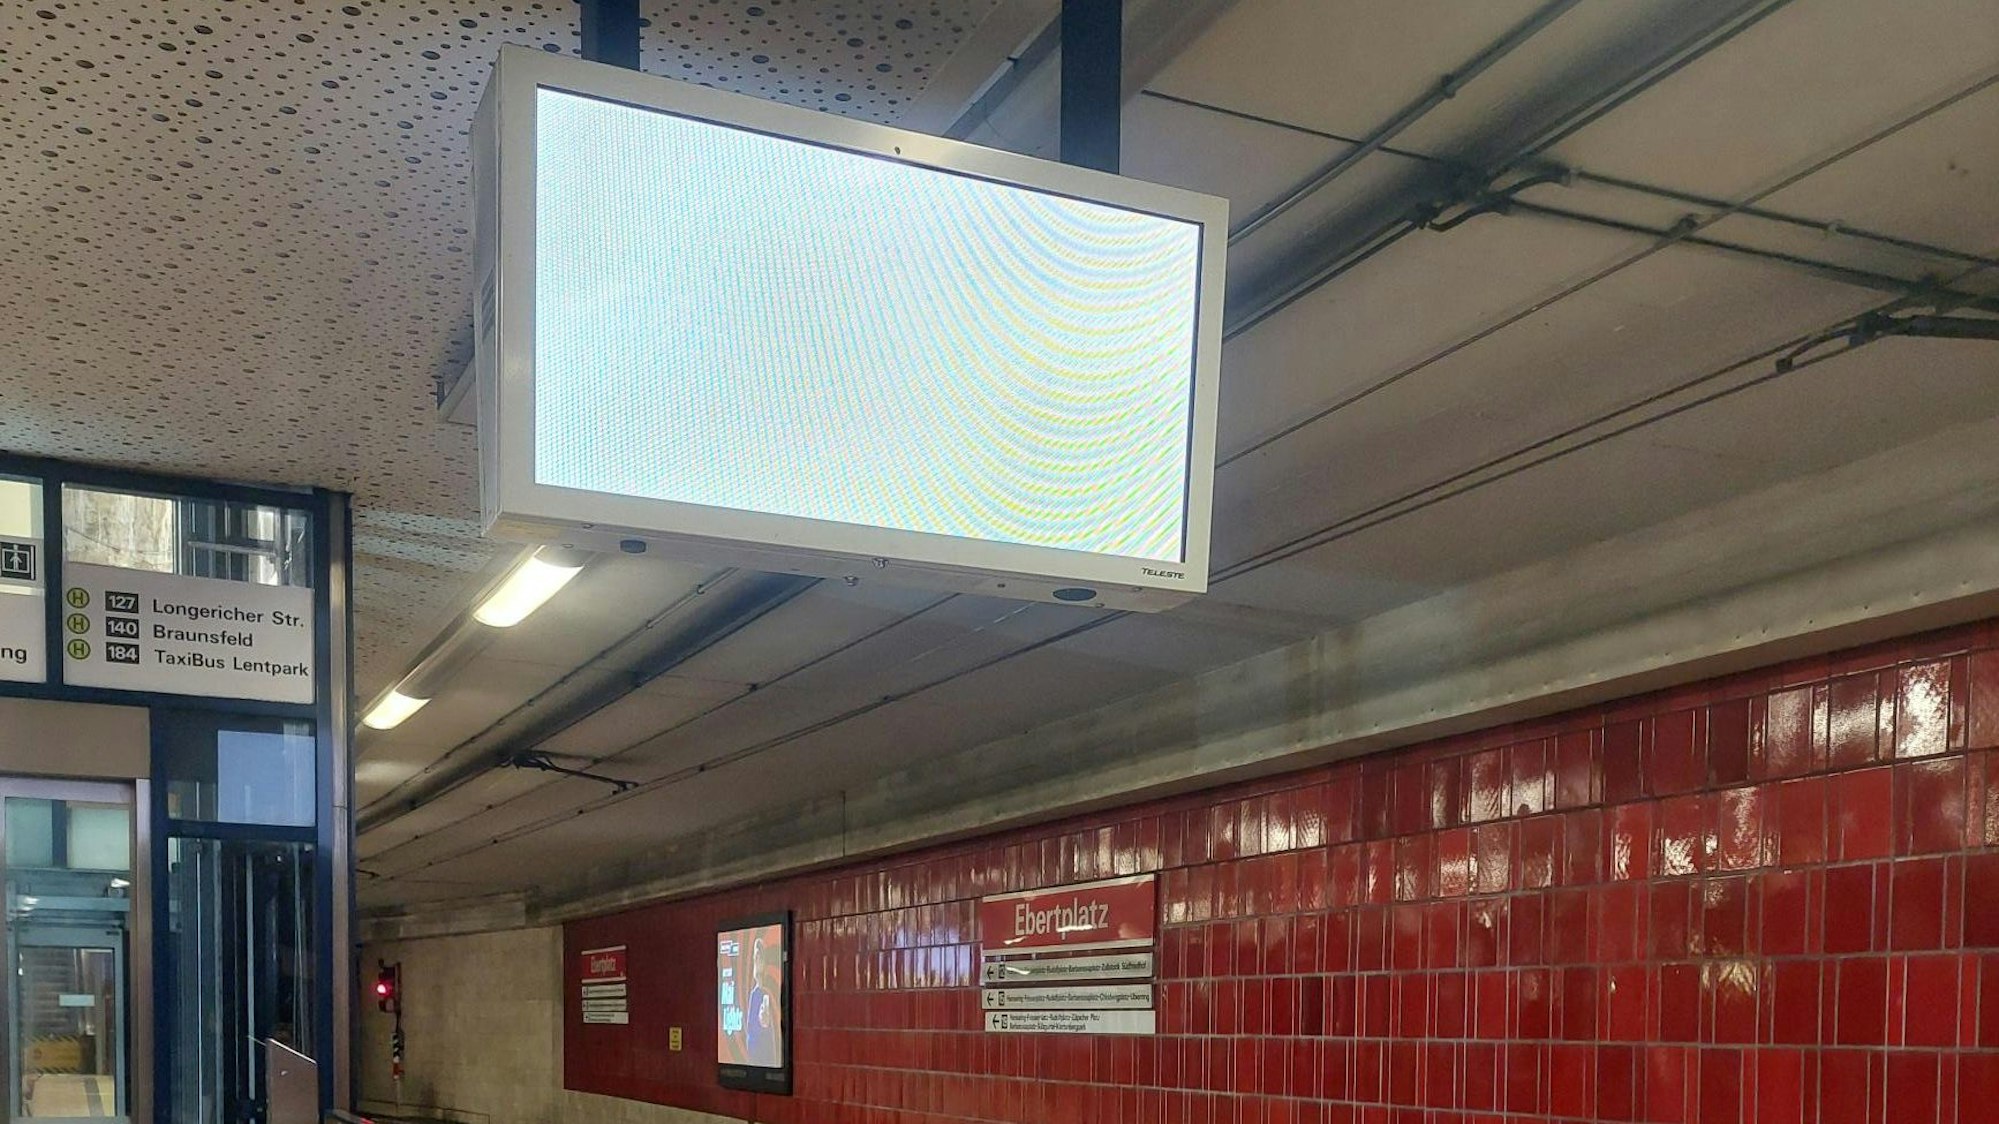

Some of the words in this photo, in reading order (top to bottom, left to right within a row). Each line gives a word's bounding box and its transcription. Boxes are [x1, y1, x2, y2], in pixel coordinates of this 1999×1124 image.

[1141, 567, 1185, 580] TELESTE
[108, 594, 136, 610] 127
[152, 598, 264, 623] Longericher
[271, 610, 305, 628] Str.
[108, 619, 137, 636] 140
[153, 625, 253, 647] Braunsfeld
[109, 644, 137, 661] 184
[154, 649, 225, 670] TaxiBus
[233, 656, 309, 677] Lentpark
[1015, 897, 1109, 940] Ebertplatz
